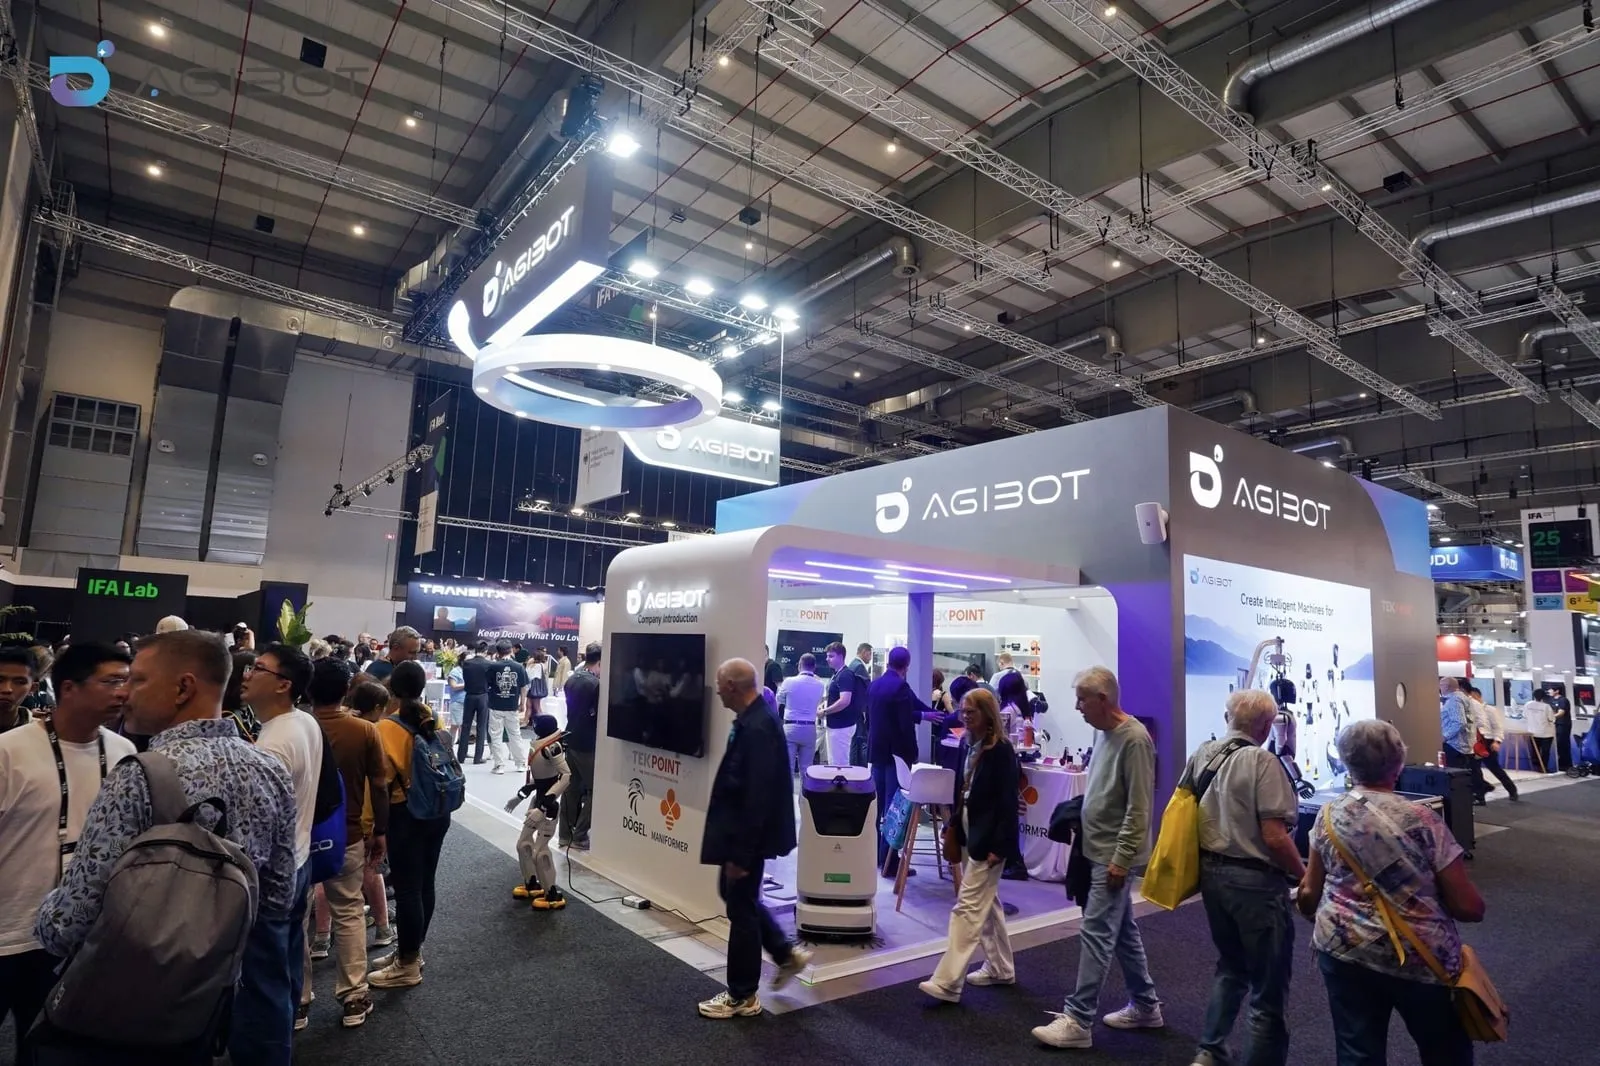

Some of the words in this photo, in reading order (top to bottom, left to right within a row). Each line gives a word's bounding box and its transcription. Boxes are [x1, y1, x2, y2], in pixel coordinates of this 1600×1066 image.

[501, 205, 575, 296] AGIBOT
[687, 439, 774, 465] AGIBOT
[921, 468, 1091, 521] AGIBOT
[1232, 477, 1331, 530] AGIBOT
[1528, 512, 1542, 520] IFA
[1533, 530, 1560, 546] 25
[87, 578, 119, 596] IFA
[123, 581, 159, 598] Lab
[1201, 575, 1233, 588] AGIBOT
[644, 588, 707, 609] AGIBOT
[1240, 592, 1264, 607] Create
[1264, 596, 1296, 613] Intelligent
[1297, 601, 1325, 615] Machines
[1325, 604, 1335, 616] for
[637, 614, 662, 627] Company
[1256, 613, 1287, 628] Unlimited
[1288, 617, 1323, 632] Possibilities
[478, 628, 500, 639] Keep
[501, 630, 526, 641] Doing
[527, 631, 549, 640] What
[550, 633, 566, 641] You
[651, 831, 689, 853] MANIFORMER
